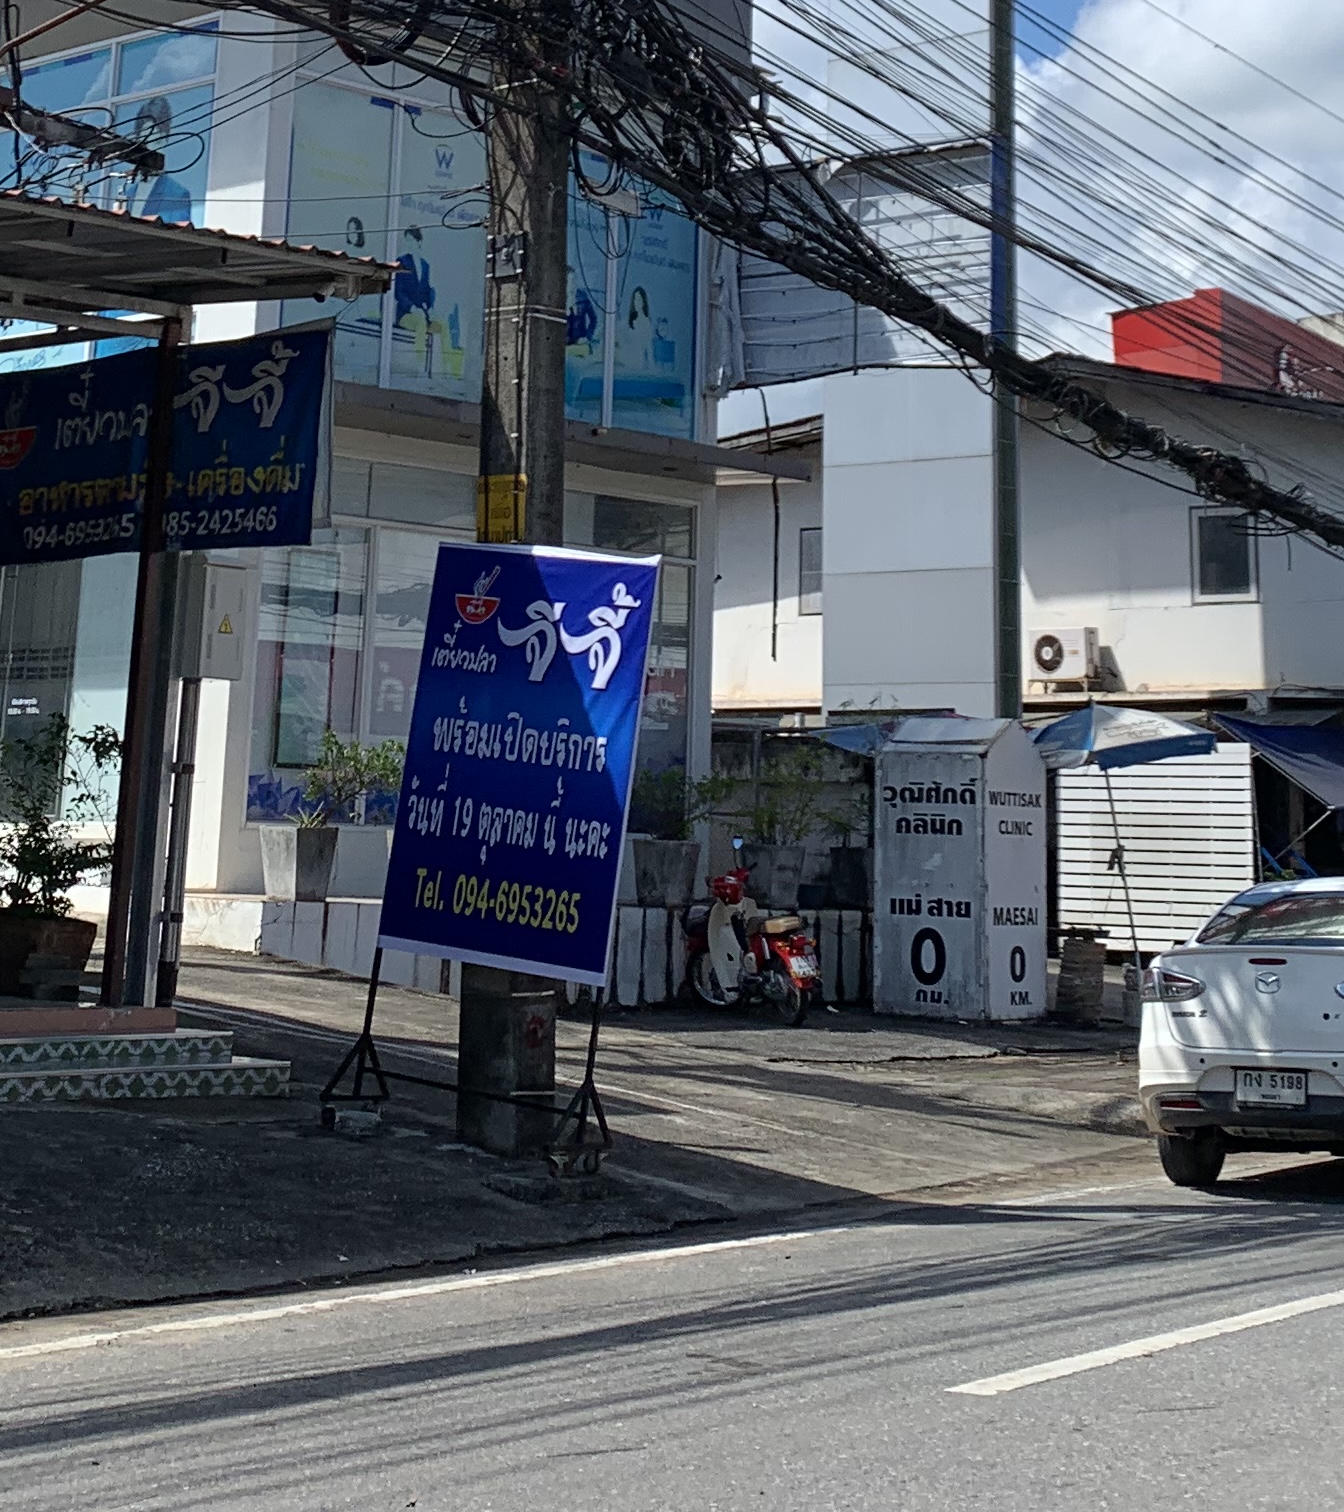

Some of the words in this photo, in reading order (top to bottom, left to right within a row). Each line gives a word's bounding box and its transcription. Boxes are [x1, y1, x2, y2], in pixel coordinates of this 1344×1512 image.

[53, 364, 153, 451] เตี๋ยวปล
[433, 695, 608, 775] พร้อมเปิดบริการ
[882, 778, 979, 809] วุฒิศักดิ์
[988, 790, 1043, 809] WUTTISAK
[407, 763, 450, 838] วันที่
[452, 798, 473, 839] 19
[478, 806, 539, 866] ตุลาคม
[565, 818, 611, 860] นะคะ
[895, 812, 964, 837] คลินิก
[998, 819, 1034, 837] CLINIC
[415, 868, 444, 913] Tel.
[452, 874, 581, 935] 094-6953265
[992, 906, 1039, 926] MAESAI
[910, 926, 947, 986] 0
[1009, 945, 1027, 983] 0
[915, 987, 950, 1005] กม.
[1010, 990, 1033, 1007] KM.
